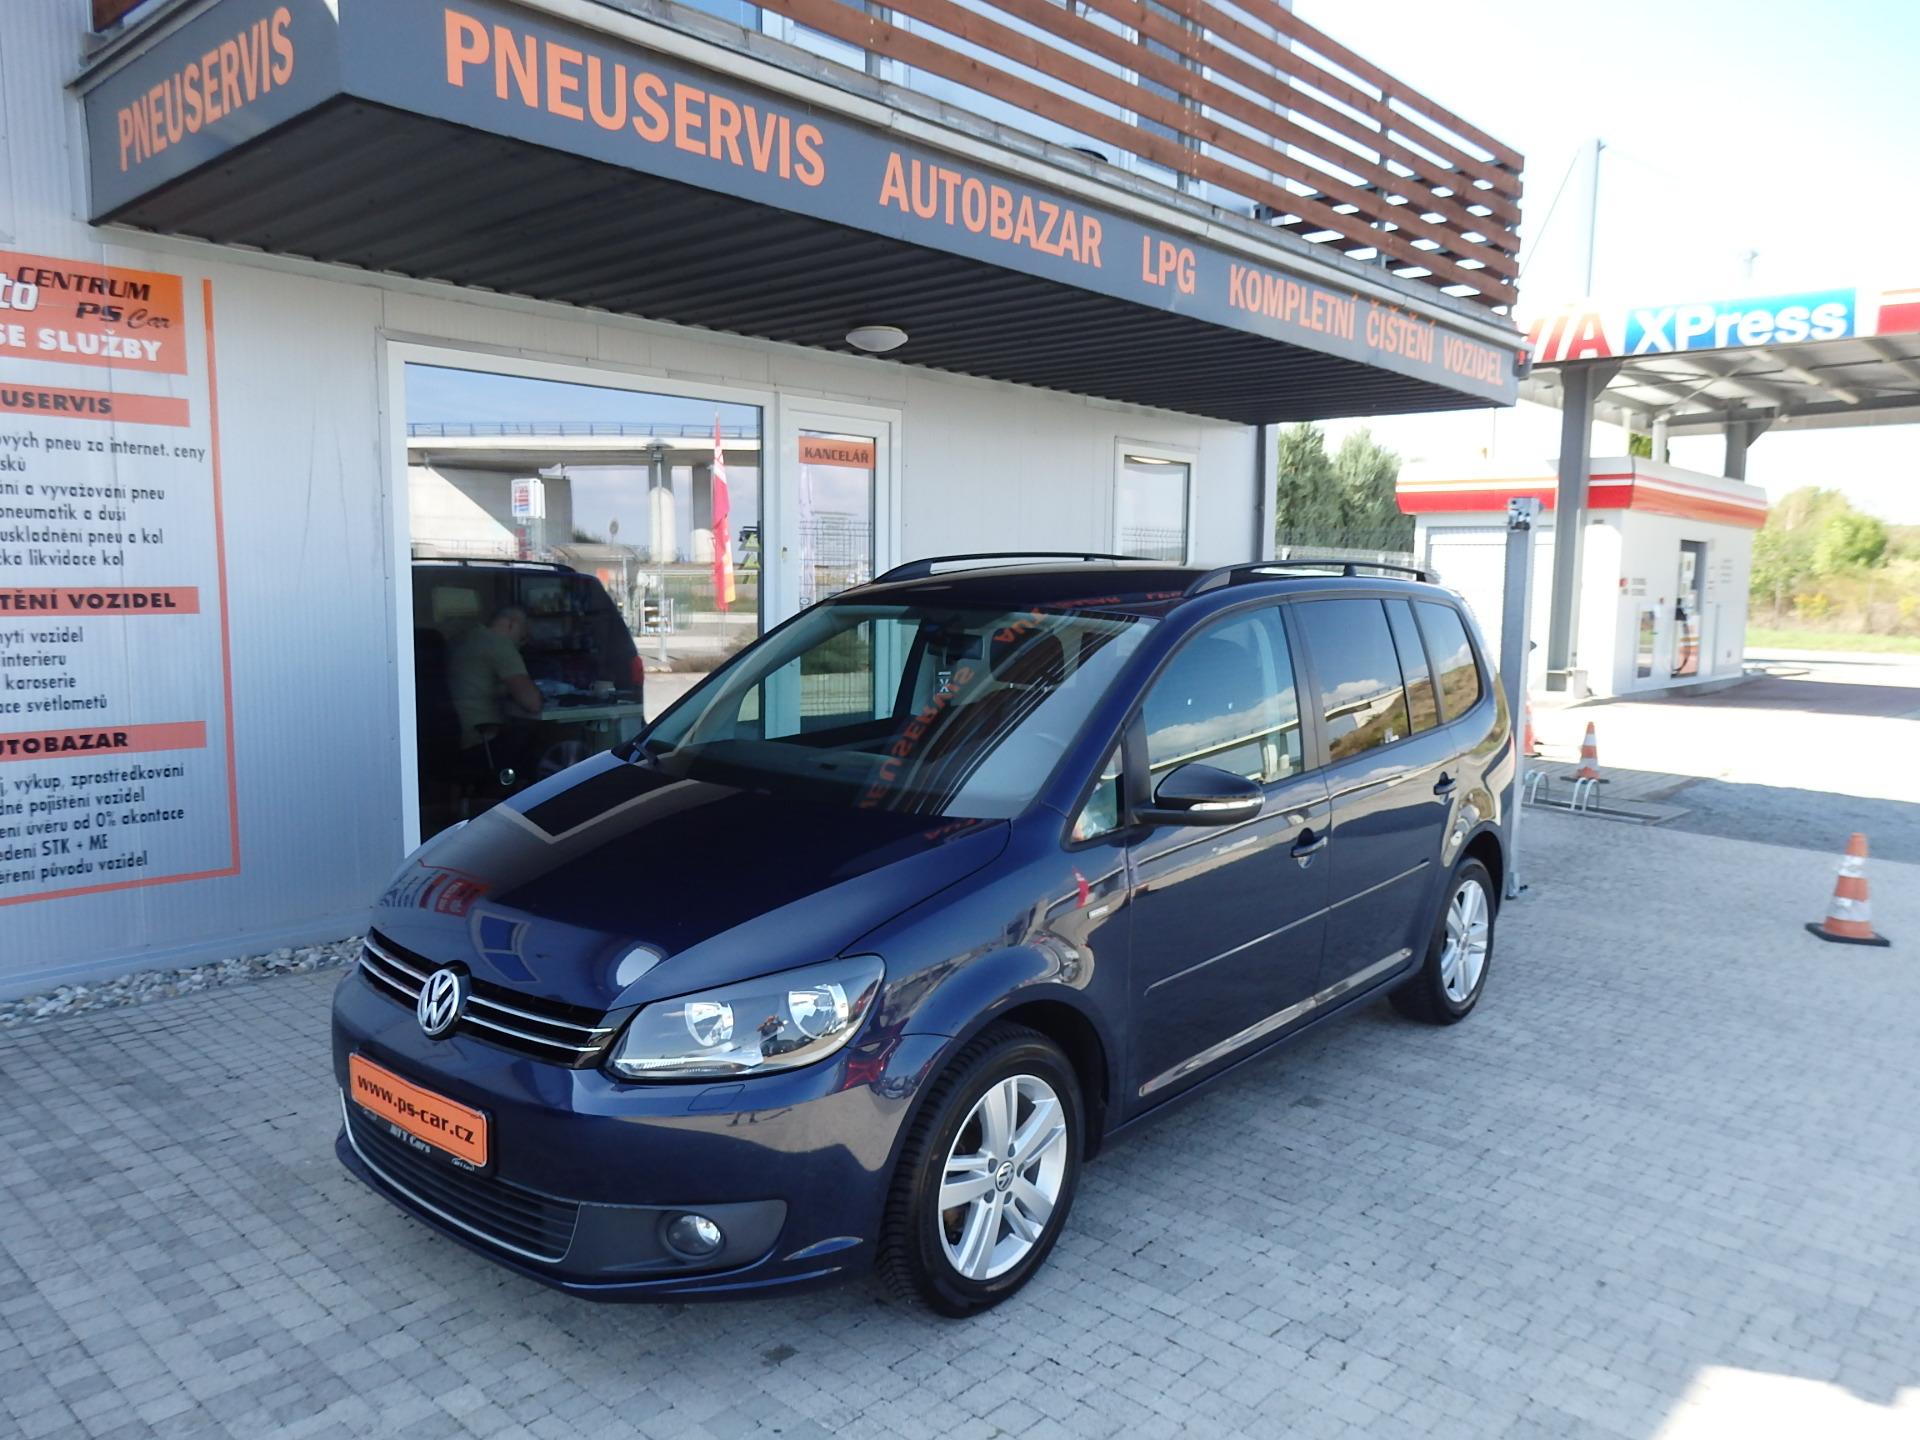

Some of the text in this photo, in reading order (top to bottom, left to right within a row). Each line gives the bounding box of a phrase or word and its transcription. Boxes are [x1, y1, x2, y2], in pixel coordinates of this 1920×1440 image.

[117, 6, 295, 172] PNEUSERVIS
[444, 8, 1504, 386] PNEUSERVIS AUTOBAZAR LPG KOMPLETNÍ ČIŠTĚNÍ VOZIDEL
[17, 266, 152, 301] CENTRUM
[76, 302, 123, 322] PS
[1632, 302, 1850, 356] XPress
[38, 328, 162, 362] SLUŽBY
[1, 389, 113, 414] USERVIS
[45, 437, 81, 453] pneu
[87, 441, 104, 452] za
[174, 447, 206, 463] ceny
[804, 445, 869, 464] KANCELÁŘ
[25, 484, 34, 495] a
[131, 488, 165, 503] pneu
[84, 509, 93, 520] a
[88, 531, 122, 547] pneu
[128, 533, 137, 543] a
[141, 527, 163, 544] kol
[29, 548, 97, 567] likvidace
[102, 549, 124, 567] kol
[67, 592, 177, 610] VOZIDEL
[31, 626, 84, 643] vozidel
[5, 672, 77, 690] karoserie
[96, 786, 145, 806] vozidel
[73, 812, 90, 830] od
[96, 810, 117, 828] 0%
[122, 808, 184, 825] akontace
[42, 838, 70, 857] STK
[89, 833, 108, 851] ME
[98, 850, 148, 871] vozidel
[356, 1073, 476, 1147] www.ps-car.cz
